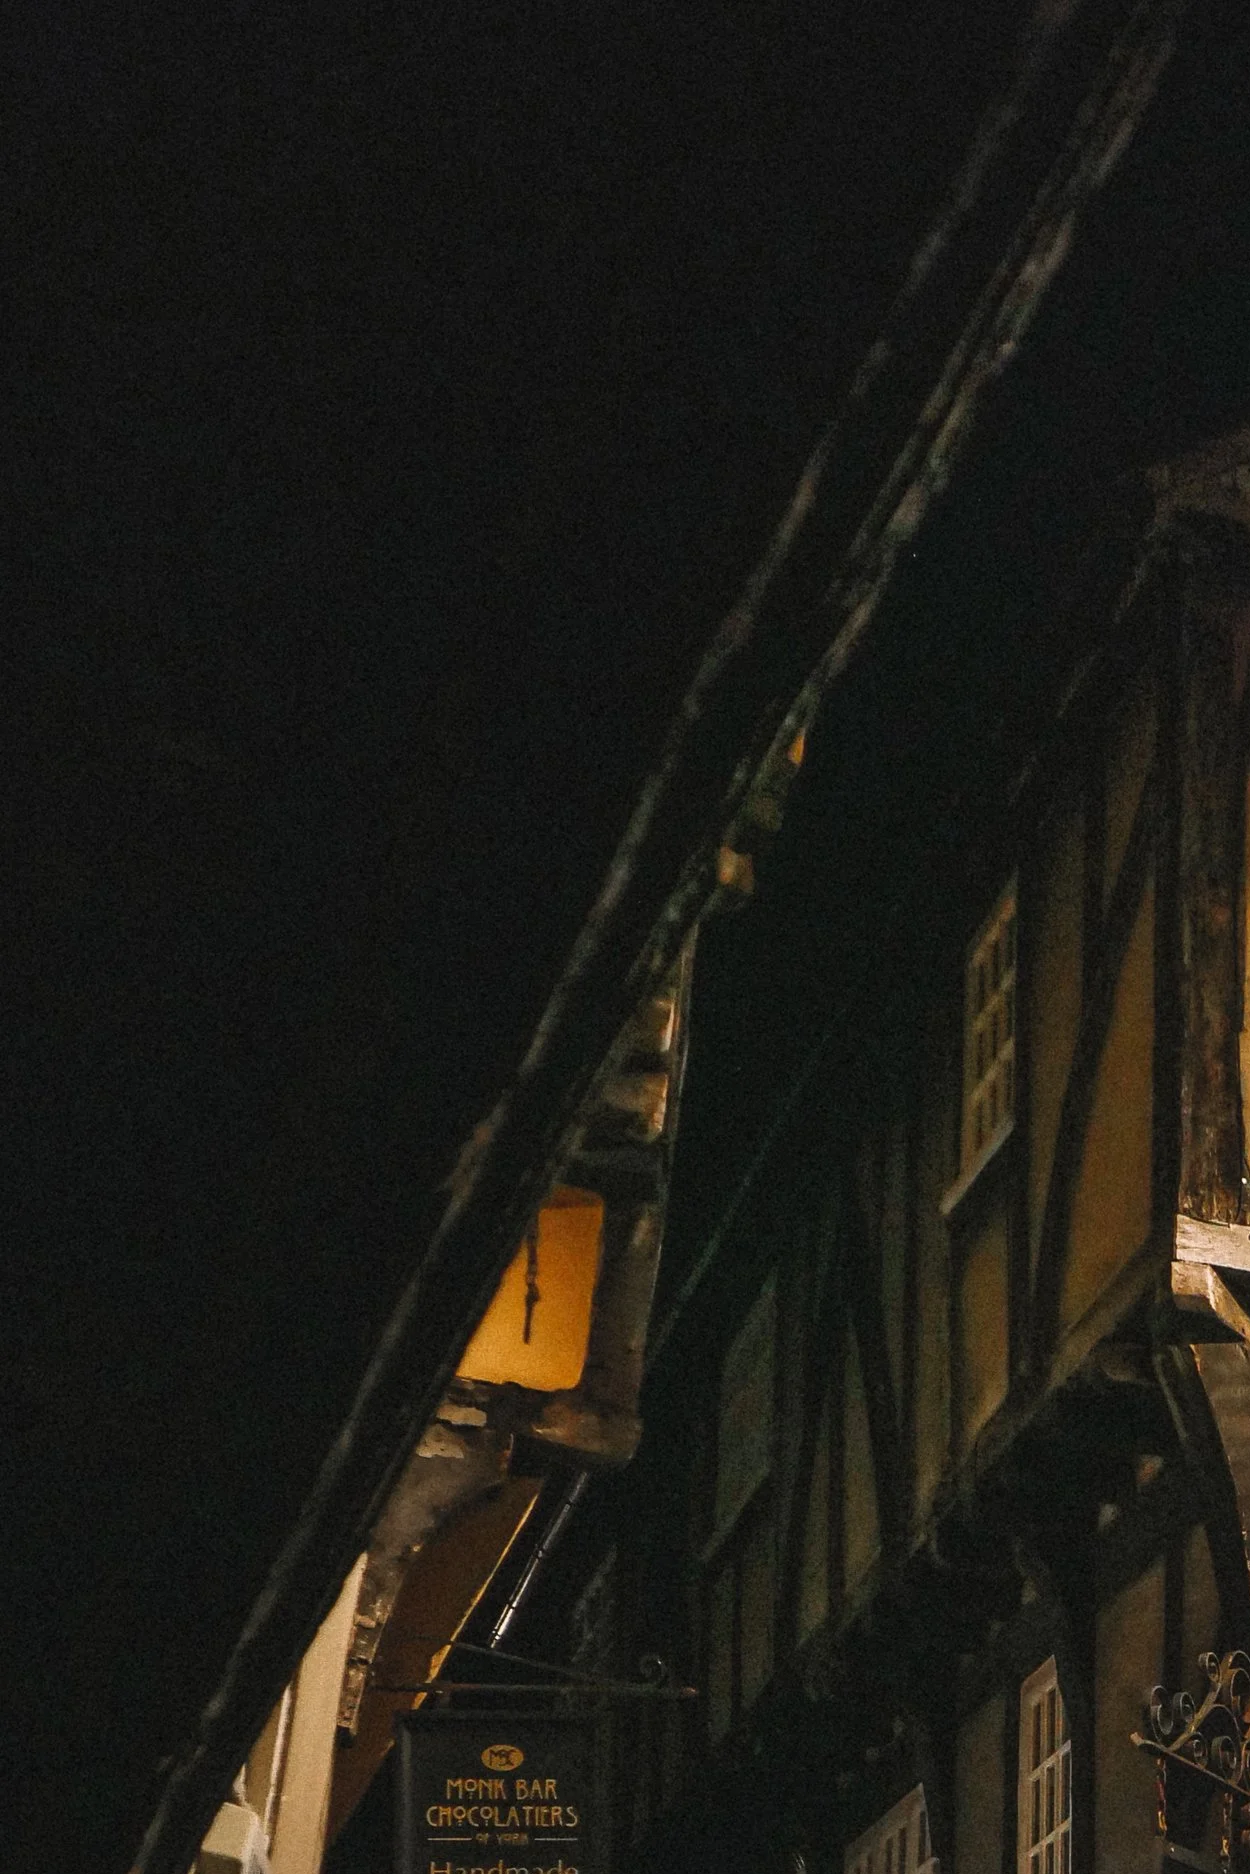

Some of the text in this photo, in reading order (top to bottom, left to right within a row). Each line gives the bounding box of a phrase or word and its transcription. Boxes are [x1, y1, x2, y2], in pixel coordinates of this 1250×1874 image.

[445, 1778, 558, 1800] MONK BAR
[426, 1805, 579, 1827] CHOCOLATIERS
